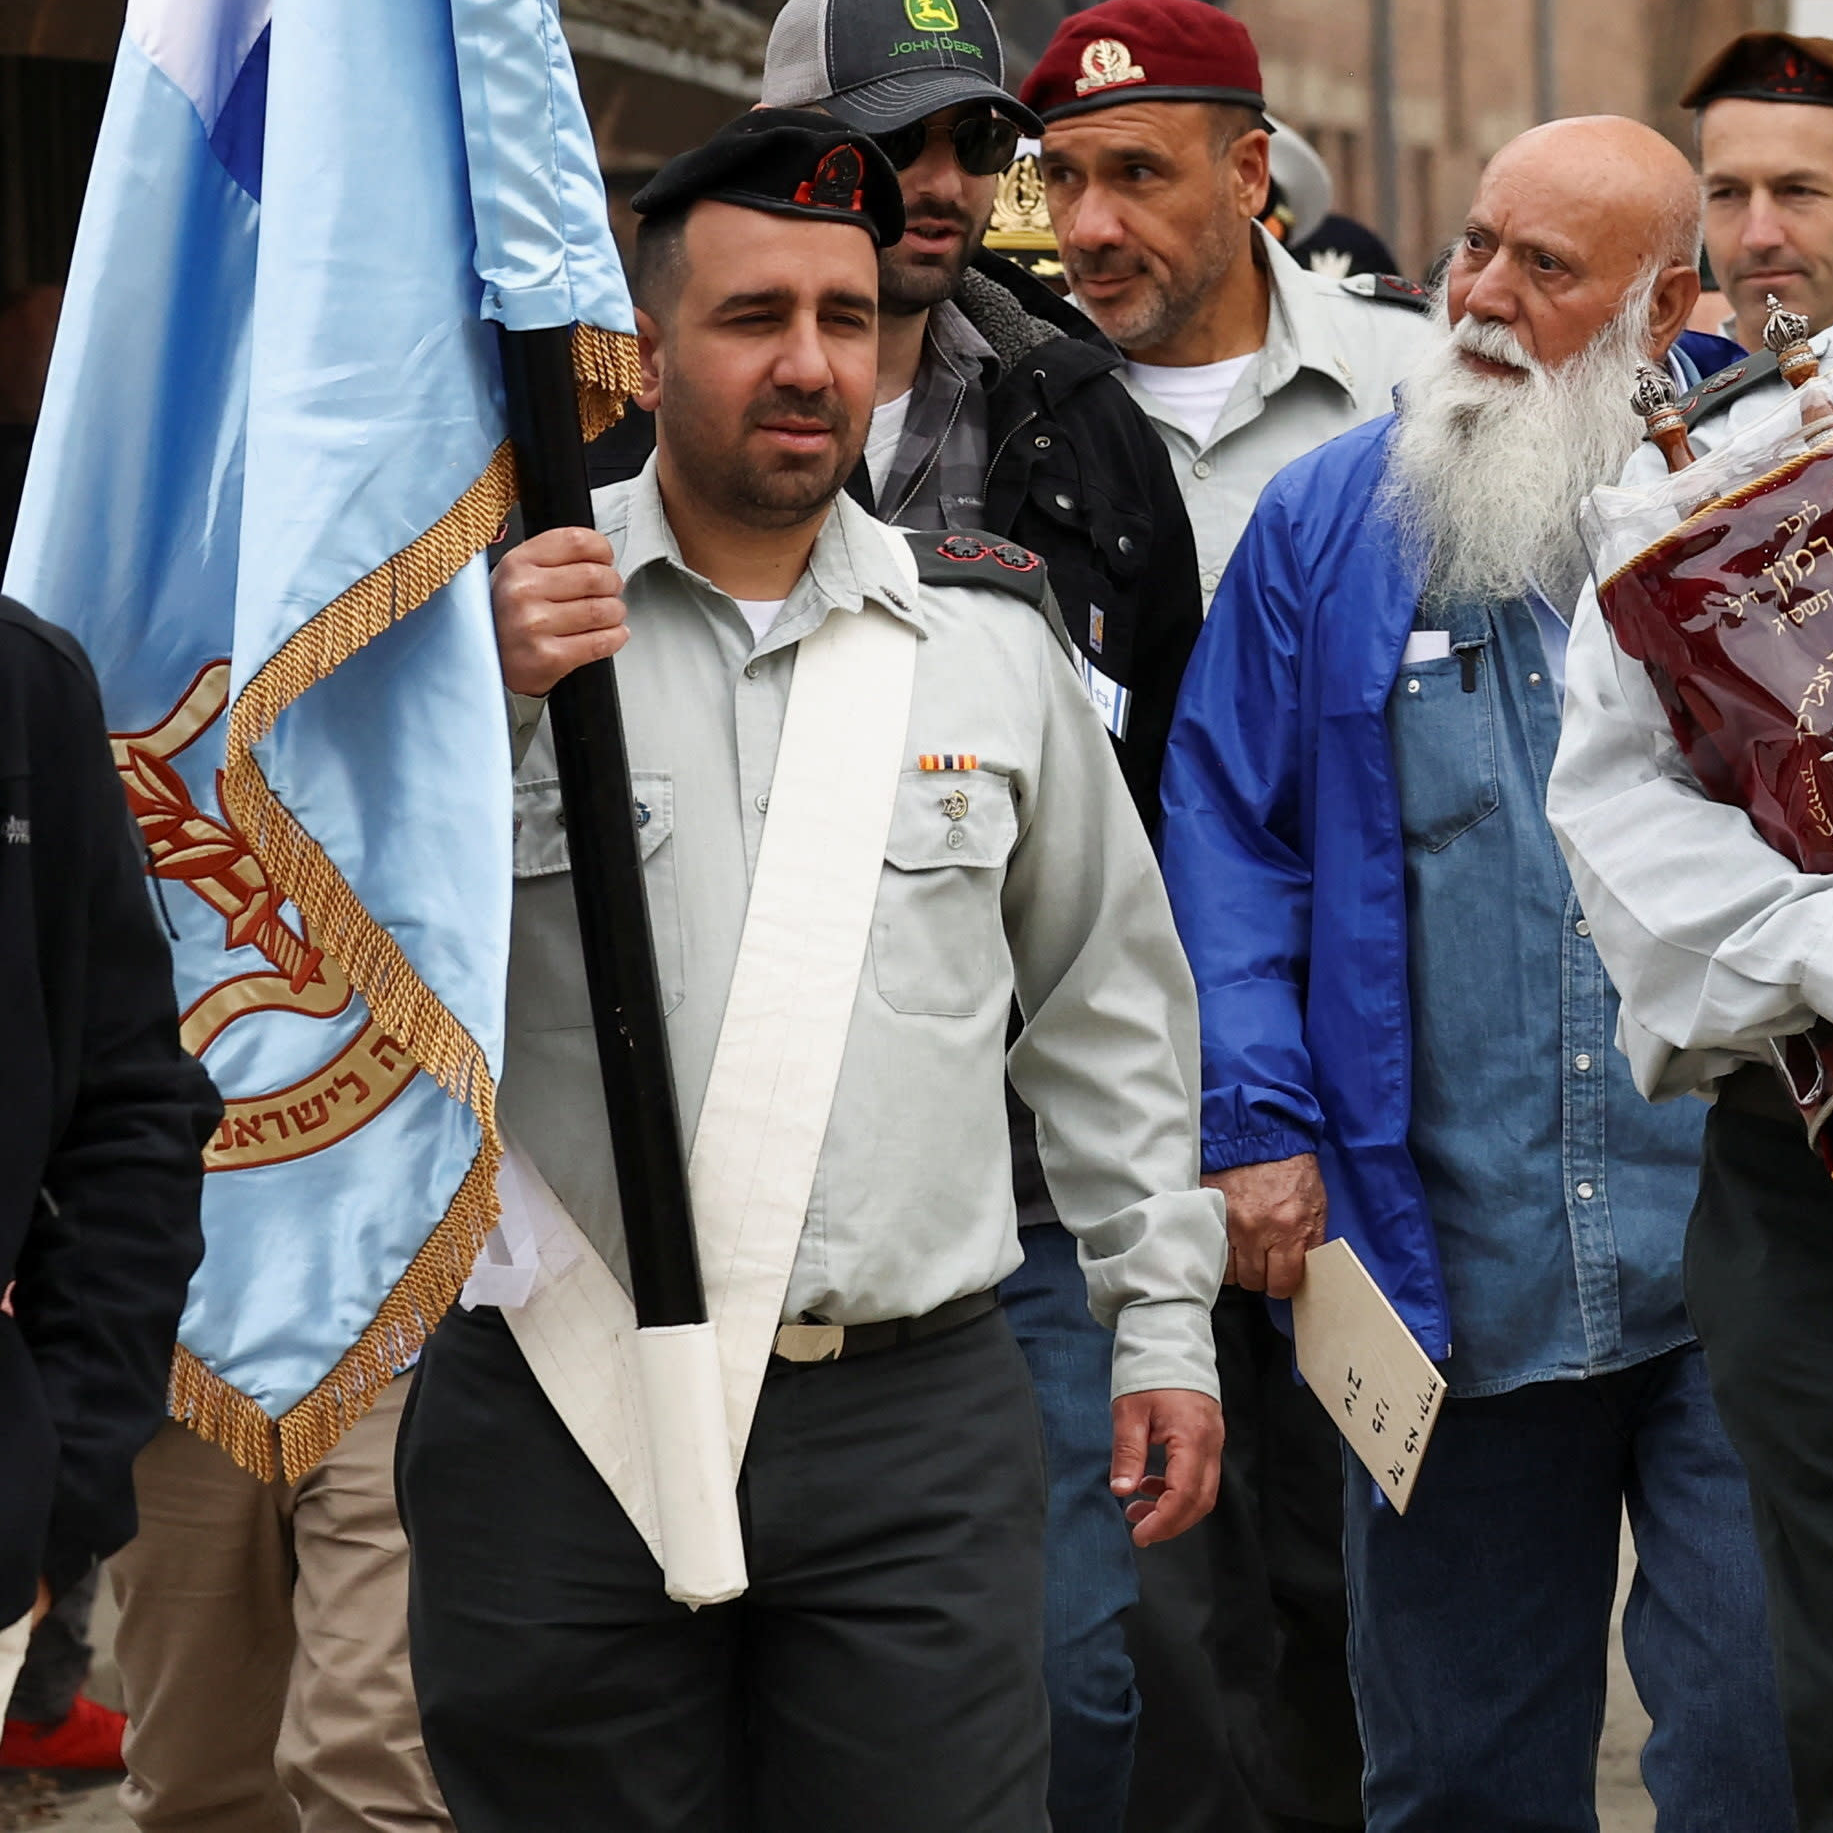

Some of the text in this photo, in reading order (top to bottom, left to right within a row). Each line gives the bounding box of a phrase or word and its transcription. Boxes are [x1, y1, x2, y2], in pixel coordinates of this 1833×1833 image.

[888, 36, 983, 59] JOHN DEERE
[1775, 500, 1821, 535] לזכר
[1344, 1366, 1363, 1418] שוב
[1372, 1396, 1391, 1434] לנו
[1387, 1377, 1437, 1486] זה לא יקרה
